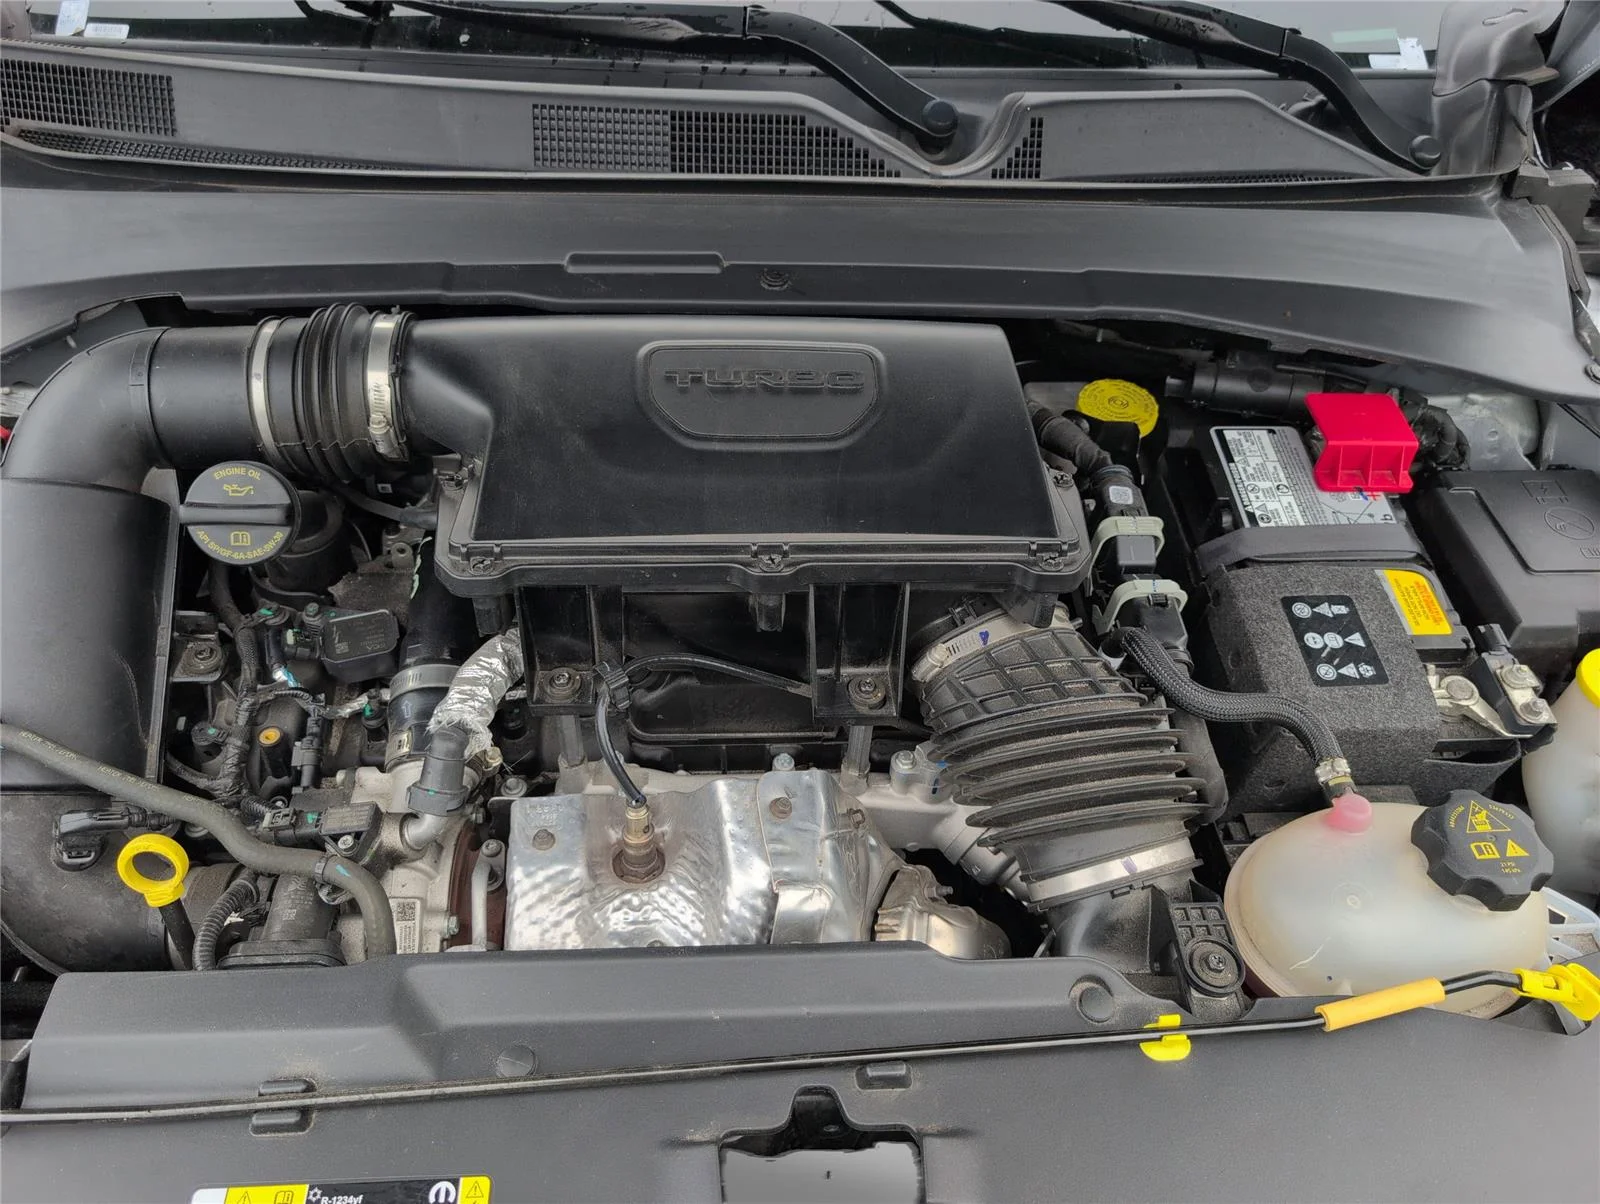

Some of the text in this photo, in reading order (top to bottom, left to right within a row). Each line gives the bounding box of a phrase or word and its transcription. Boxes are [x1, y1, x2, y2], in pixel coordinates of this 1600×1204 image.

[664, 369, 864, 393] TURBO
[213, 467, 262, 481] ENGINE OIL
[320, 1194, 364, 1204] R-1234yf
